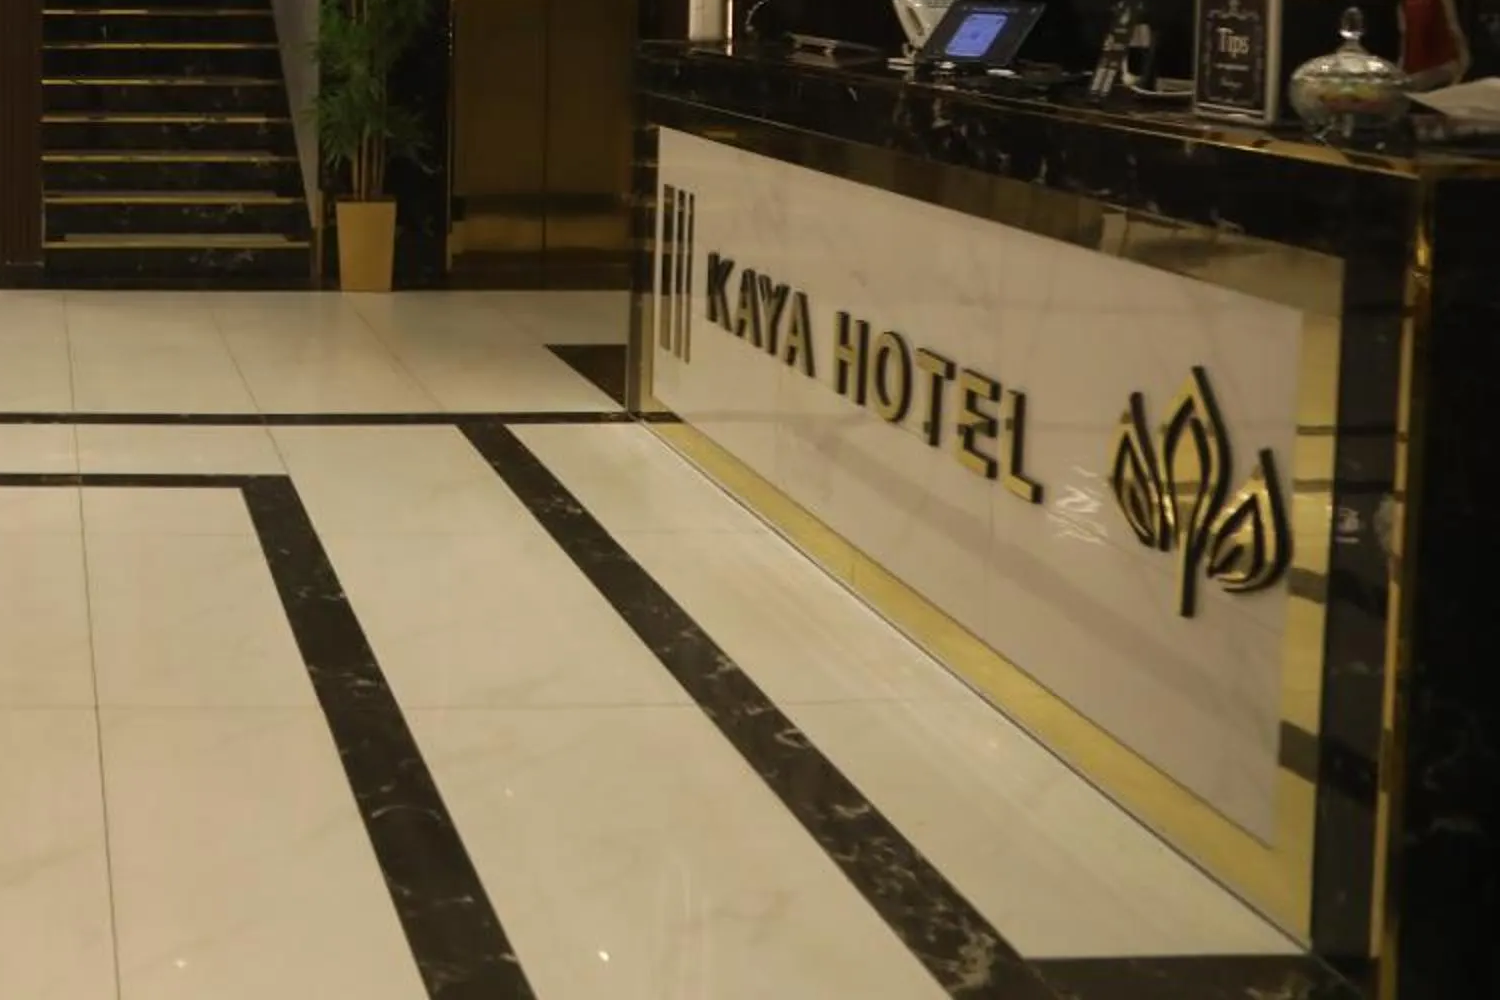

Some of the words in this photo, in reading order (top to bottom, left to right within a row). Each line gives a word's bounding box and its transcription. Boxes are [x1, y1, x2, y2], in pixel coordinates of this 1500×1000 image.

[1216, 26, 1250, 58] Tips
[706, 251, 816, 379] KAYA
[832, 311, 1044, 505] HOTEL
